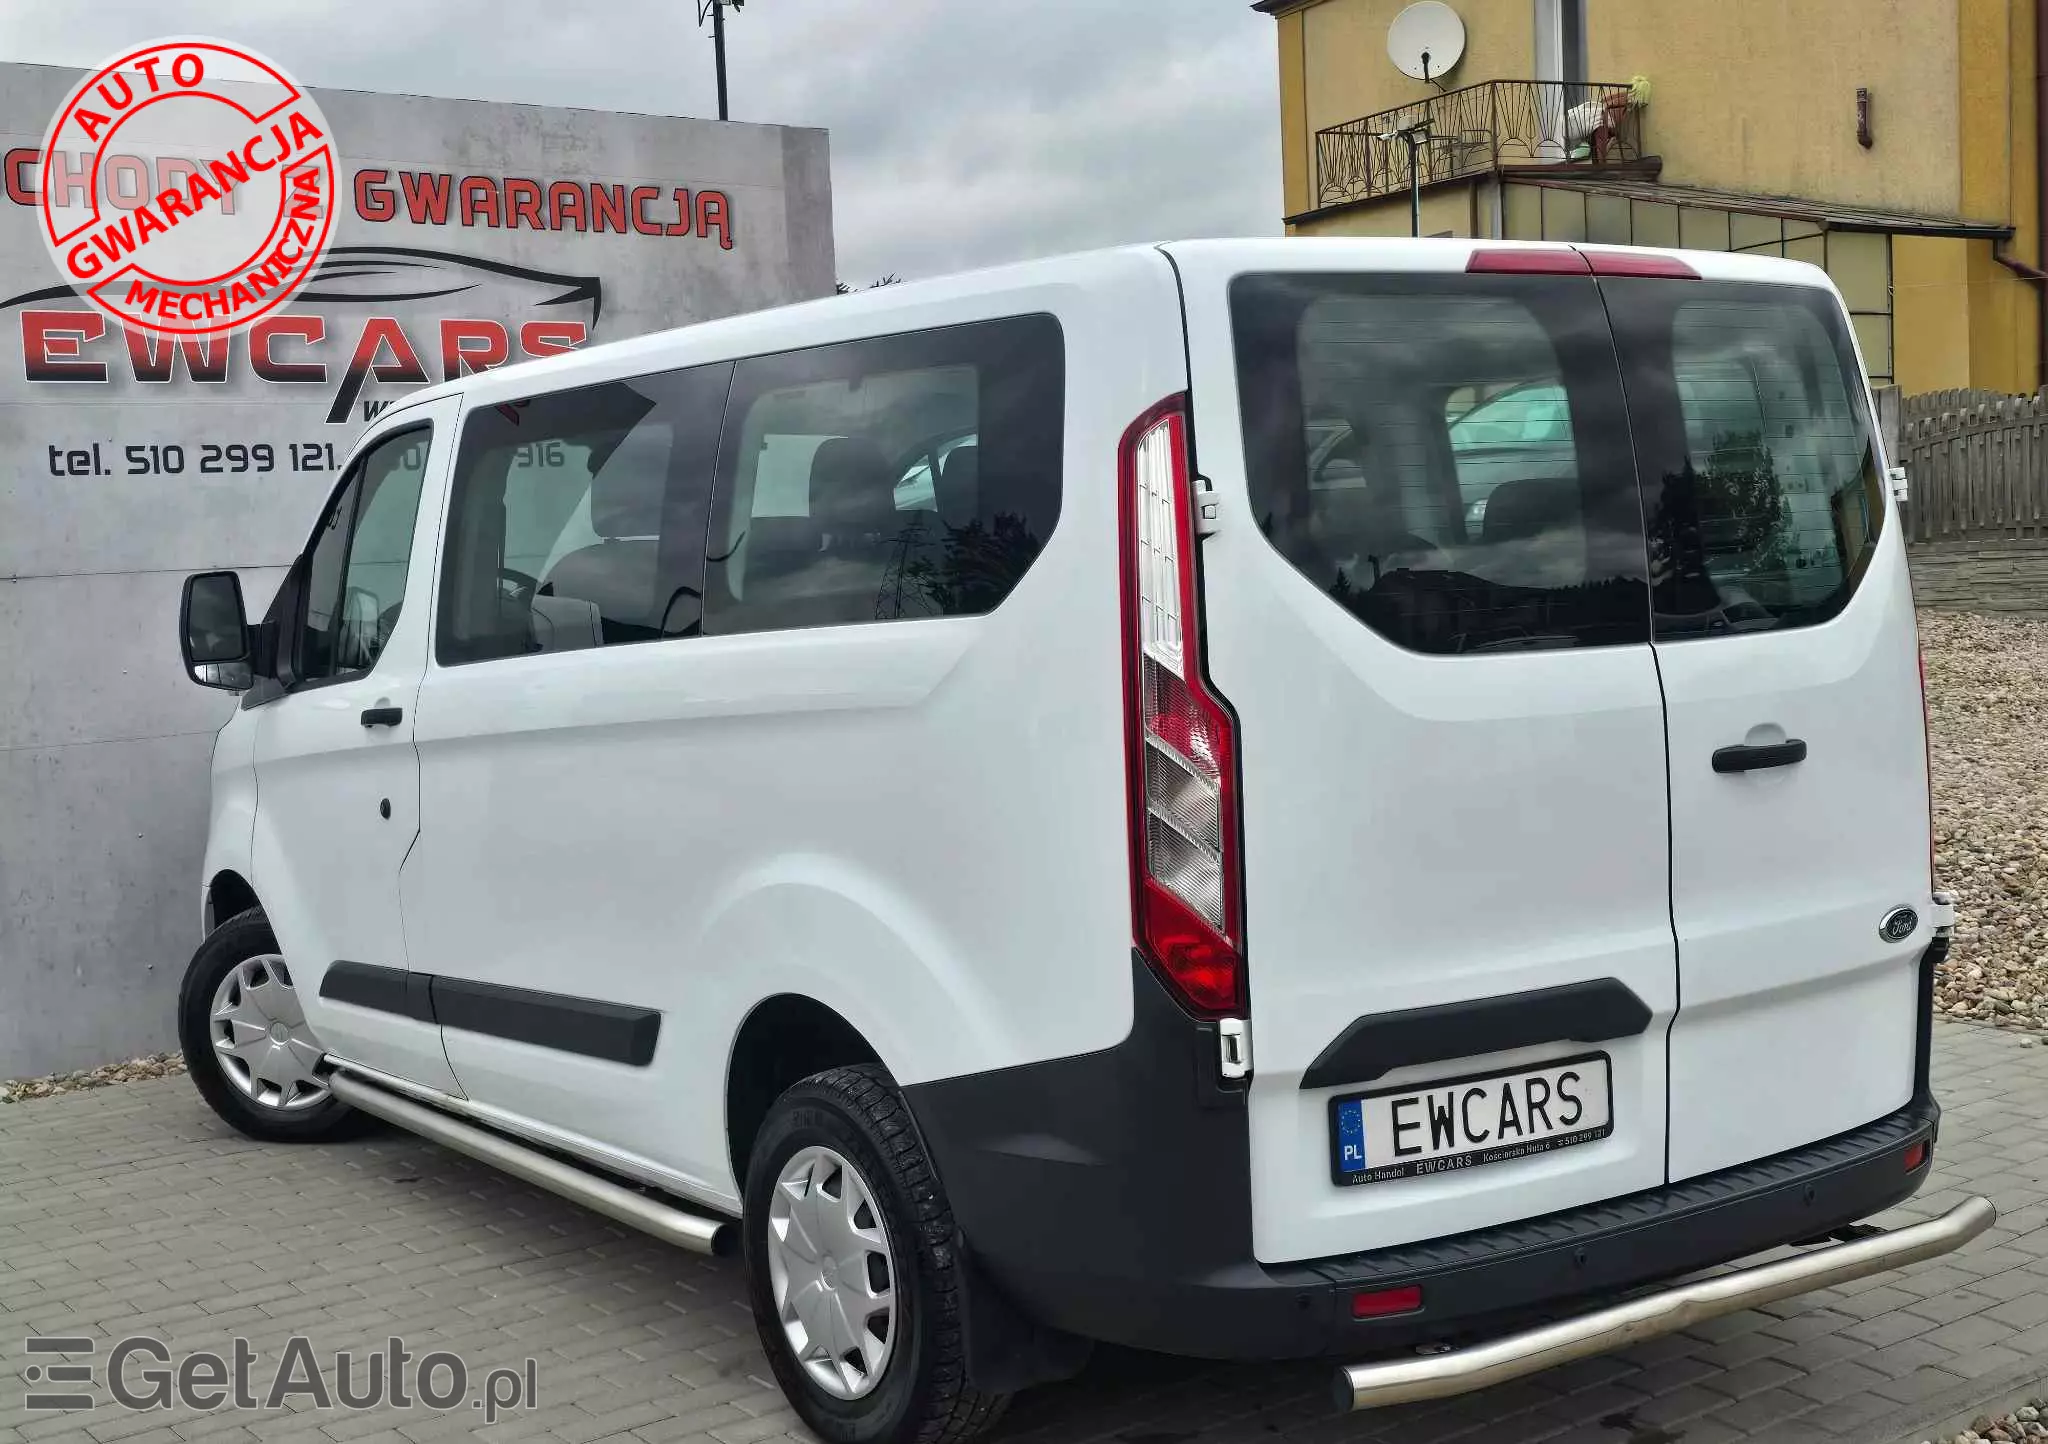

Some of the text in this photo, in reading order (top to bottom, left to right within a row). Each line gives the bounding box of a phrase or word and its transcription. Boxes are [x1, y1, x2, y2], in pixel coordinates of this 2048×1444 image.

[353, 169, 733, 250] GWARANCJĄ
[20, 310, 587, 425] EWCARS
[48, 443, 112, 476] tel.
[125, 445, 185, 475] 510
[200, 444, 275, 473] 299
[1391, 1071, 1583, 1158] EWCARS
[1344, 1145, 1363, 1160] PL
[1352, 1173, 1373, 1184] Auto
[1416, 1155, 1472, 1175] EWCARS
